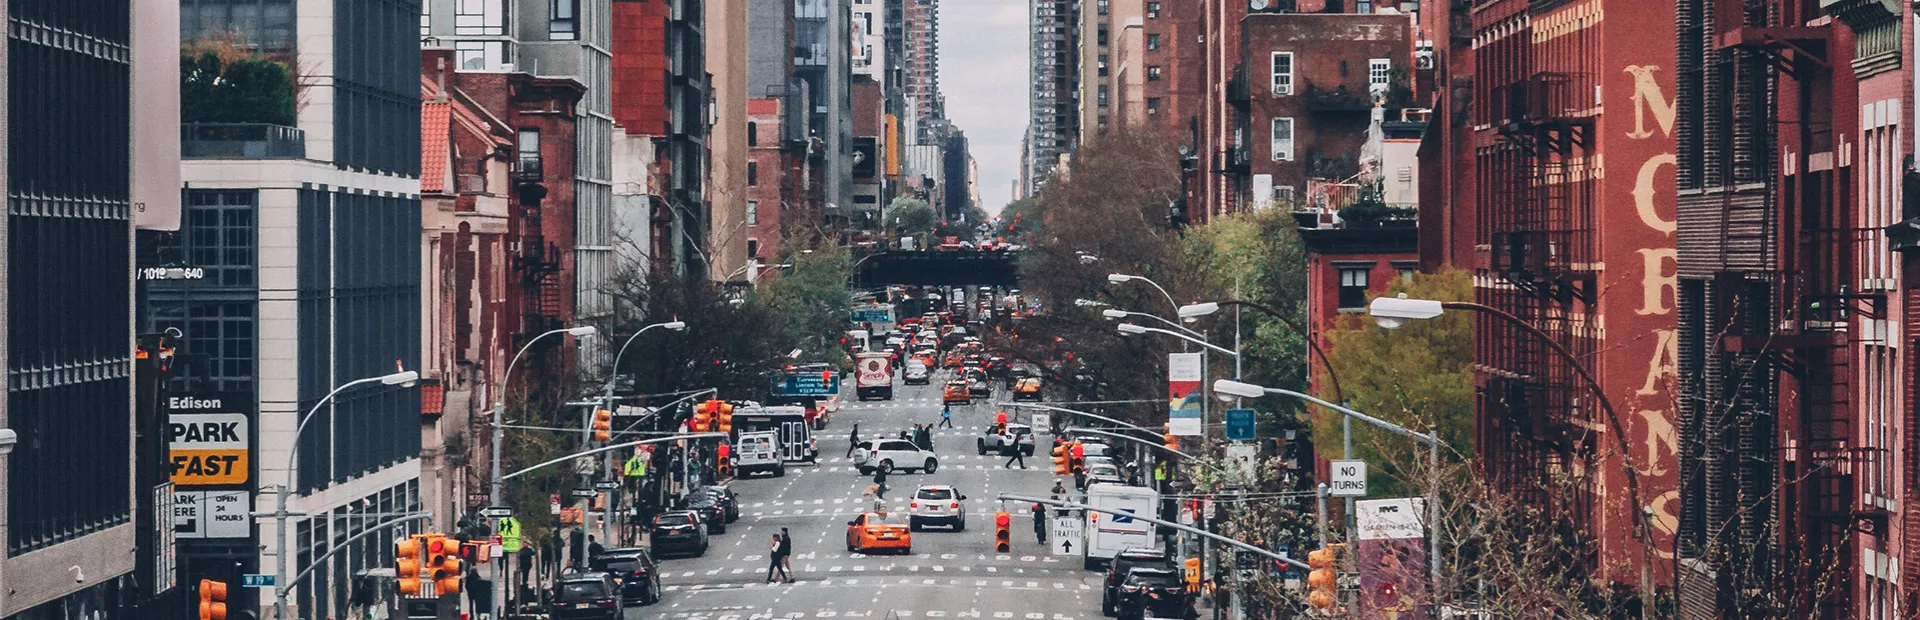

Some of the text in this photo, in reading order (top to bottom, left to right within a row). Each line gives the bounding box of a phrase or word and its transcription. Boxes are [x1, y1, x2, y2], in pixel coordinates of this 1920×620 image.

[1623, 64, 1679, 560] MORANS
[863, 372, 885, 380] Simply
[169, 396, 222, 409] Edison
[169, 422, 240, 443] PARK
[170, 455, 239, 477] FAST
[1341, 466, 1356, 477] NO
[1333, 480, 1365, 490] TURNS
[215, 495, 238, 503] OPEN
[1379, 505, 1399, 514] NYC
[215, 514, 244, 522] HOURS
[1060, 520, 1074, 528] ALL
[1054, 530, 1081, 538] TRAFFIC
[245, 576, 253, 585] W
[256, 576, 264, 585] 19
